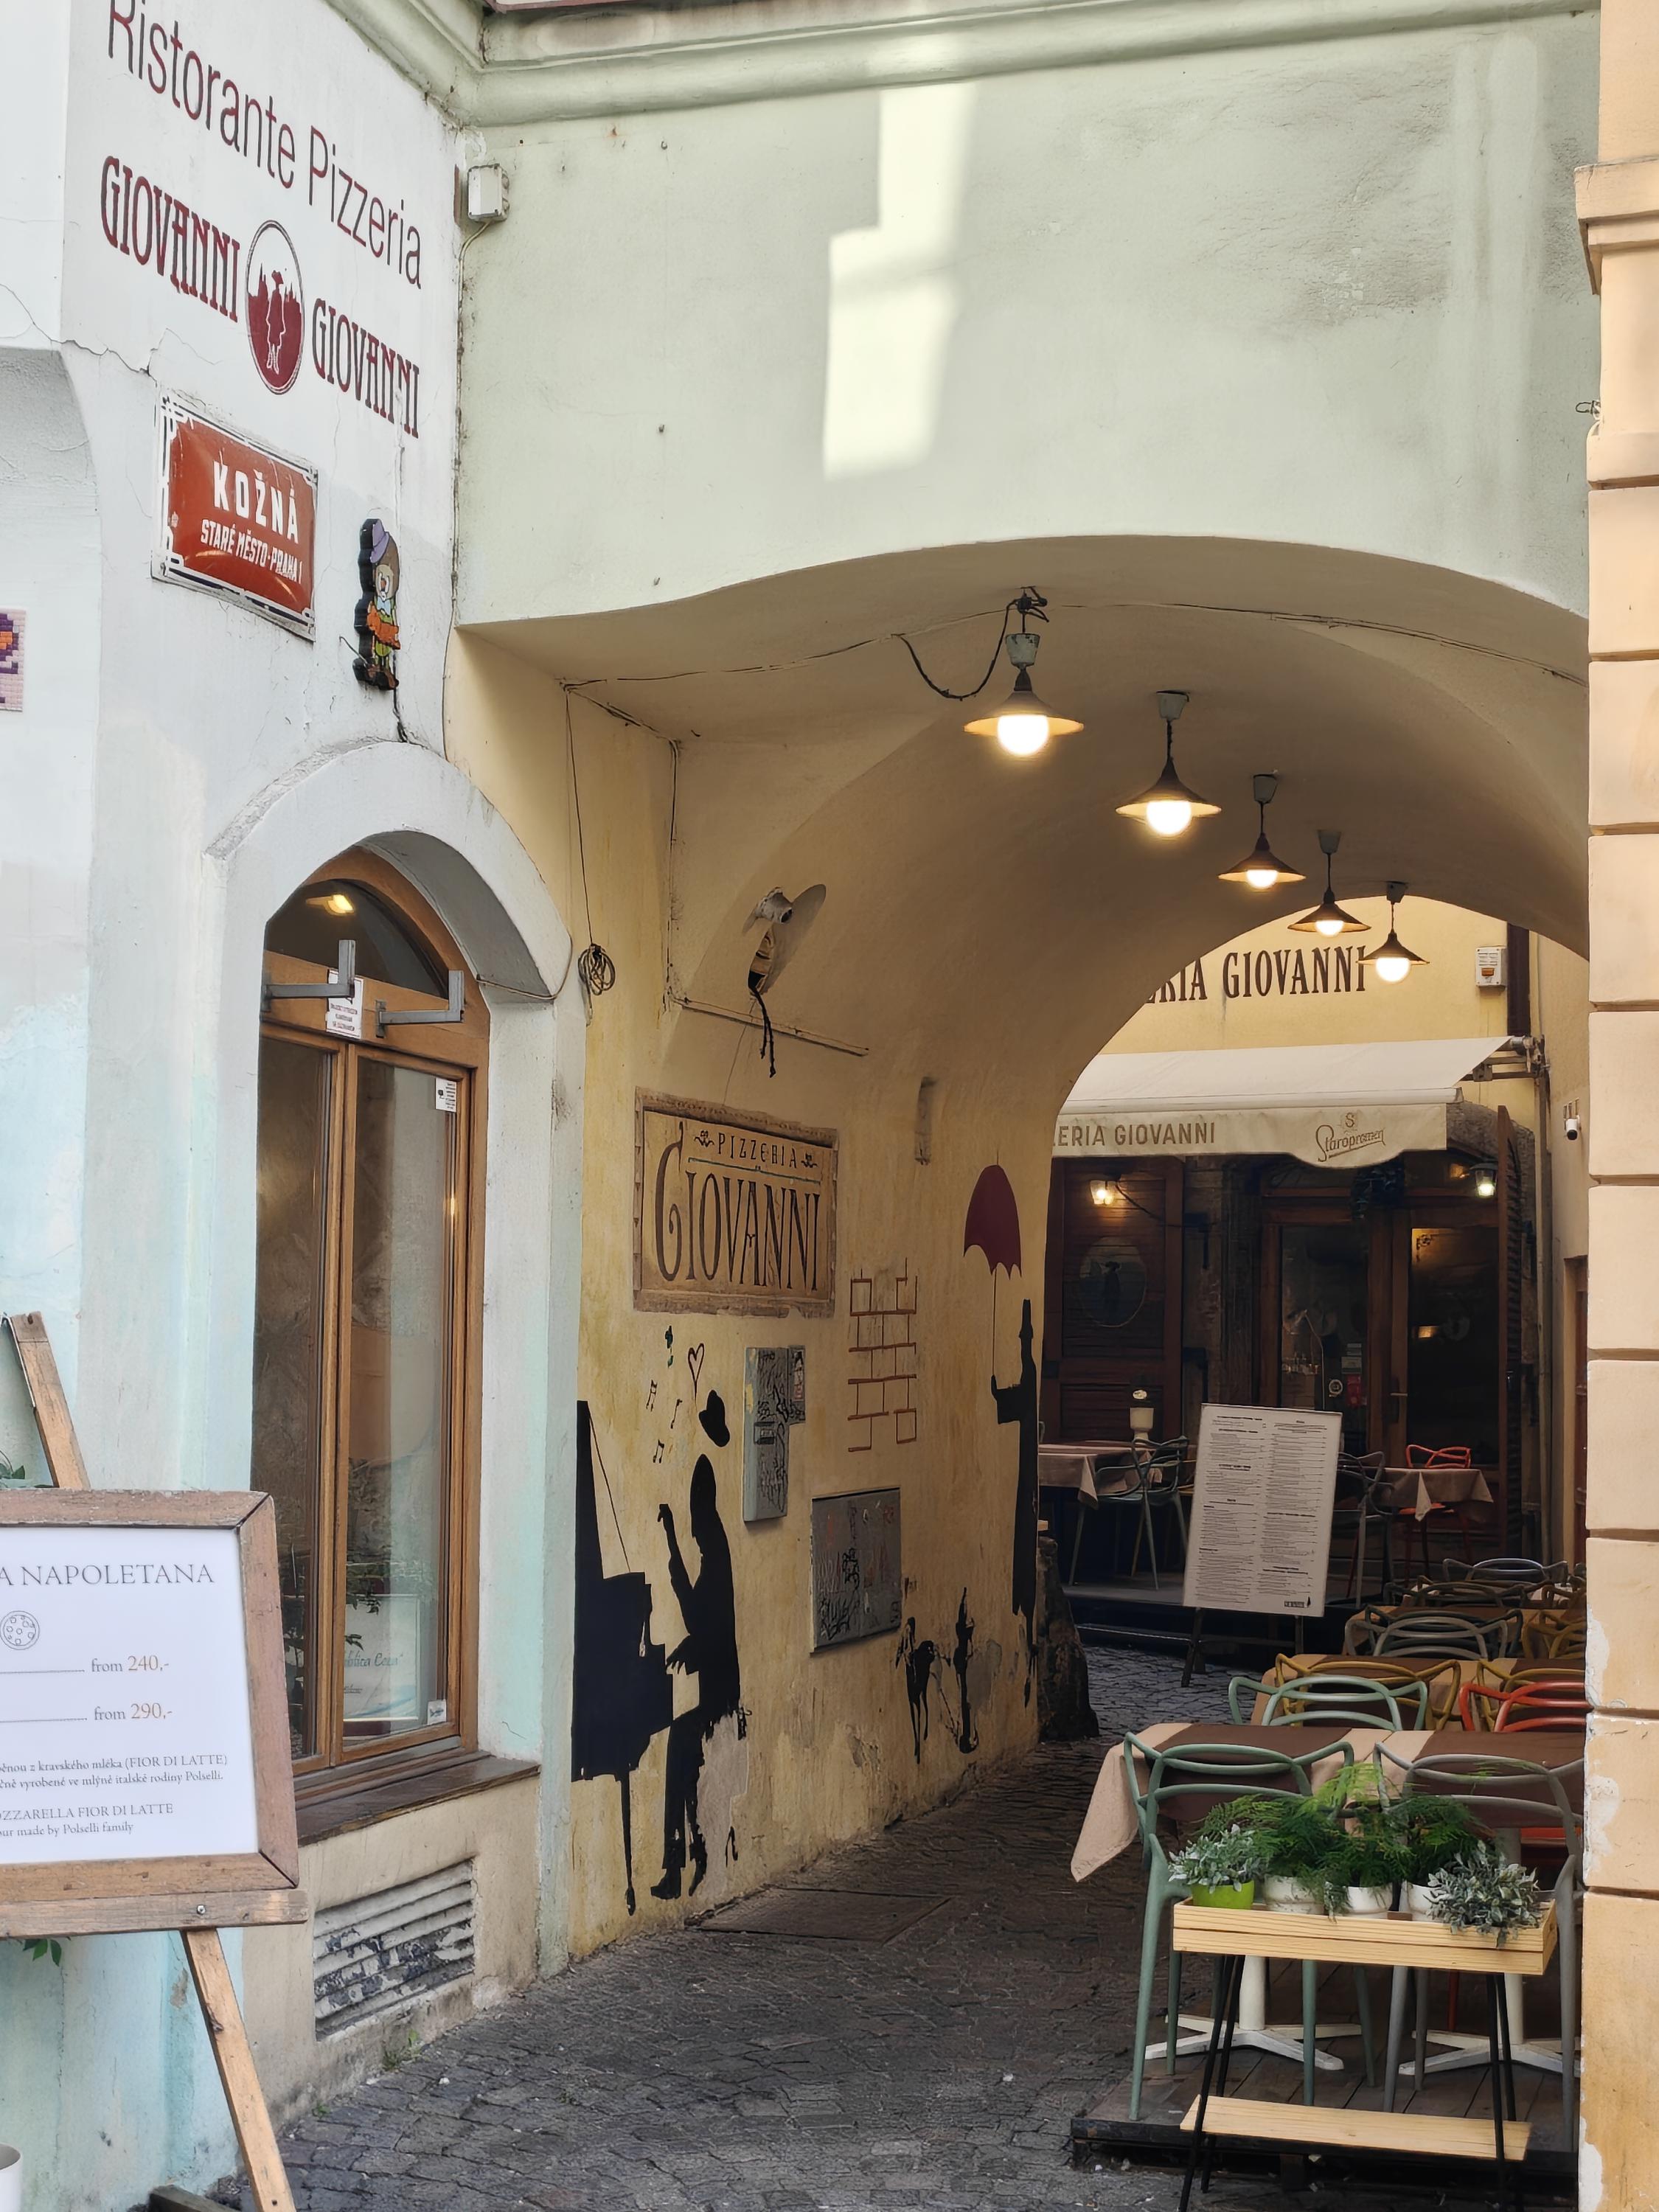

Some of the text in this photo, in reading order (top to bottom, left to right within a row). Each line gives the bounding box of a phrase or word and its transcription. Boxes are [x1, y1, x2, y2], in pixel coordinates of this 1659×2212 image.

[108, 0, 422, 290] Ristorante Pizzeria
[100, 156, 420, 439] GIOVANNI GIOVANNI
[213, 460, 299, 544] KOŽNÁ
[200, 519, 237, 554] STARÉ
[1222, 945, 1366, 998] GIOVANNI
[1053, 1122, 1216, 1147] ERIA GIOVANNI
[717, 1132, 798, 1169] PIZZERIA
[655, 1120, 821, 1291] GIOVANNI
[21, 1563, 215, 1586] NAPOLETANA
[91, 1655, 169, 1672] from 240,-
[94, 1702, 173, 1720] from 290,-
[38, 1759, 89, 1772] kravského
[92, 1758, 123, 1769] mléka
[125, 1756, 160, 1770] (FIOR
[164, 1756, 178, 1767] DI
[181, 1754, 228, 1766] LATTE)
[19, 1775, 66, 1792] vyrobené
[115, 1773, 147, 1784] italské
[150, 1771, 182, 1785] rodiny
[0, 1803, 174, 1820] ZZARELLA FIOR DI LATTE
[17, 1825, 44, 1836] made
[47, 1823, 60, 1837] by
[63, 1823, 100, 1834] Polselli
[102, 1822, 134, 1834] family
